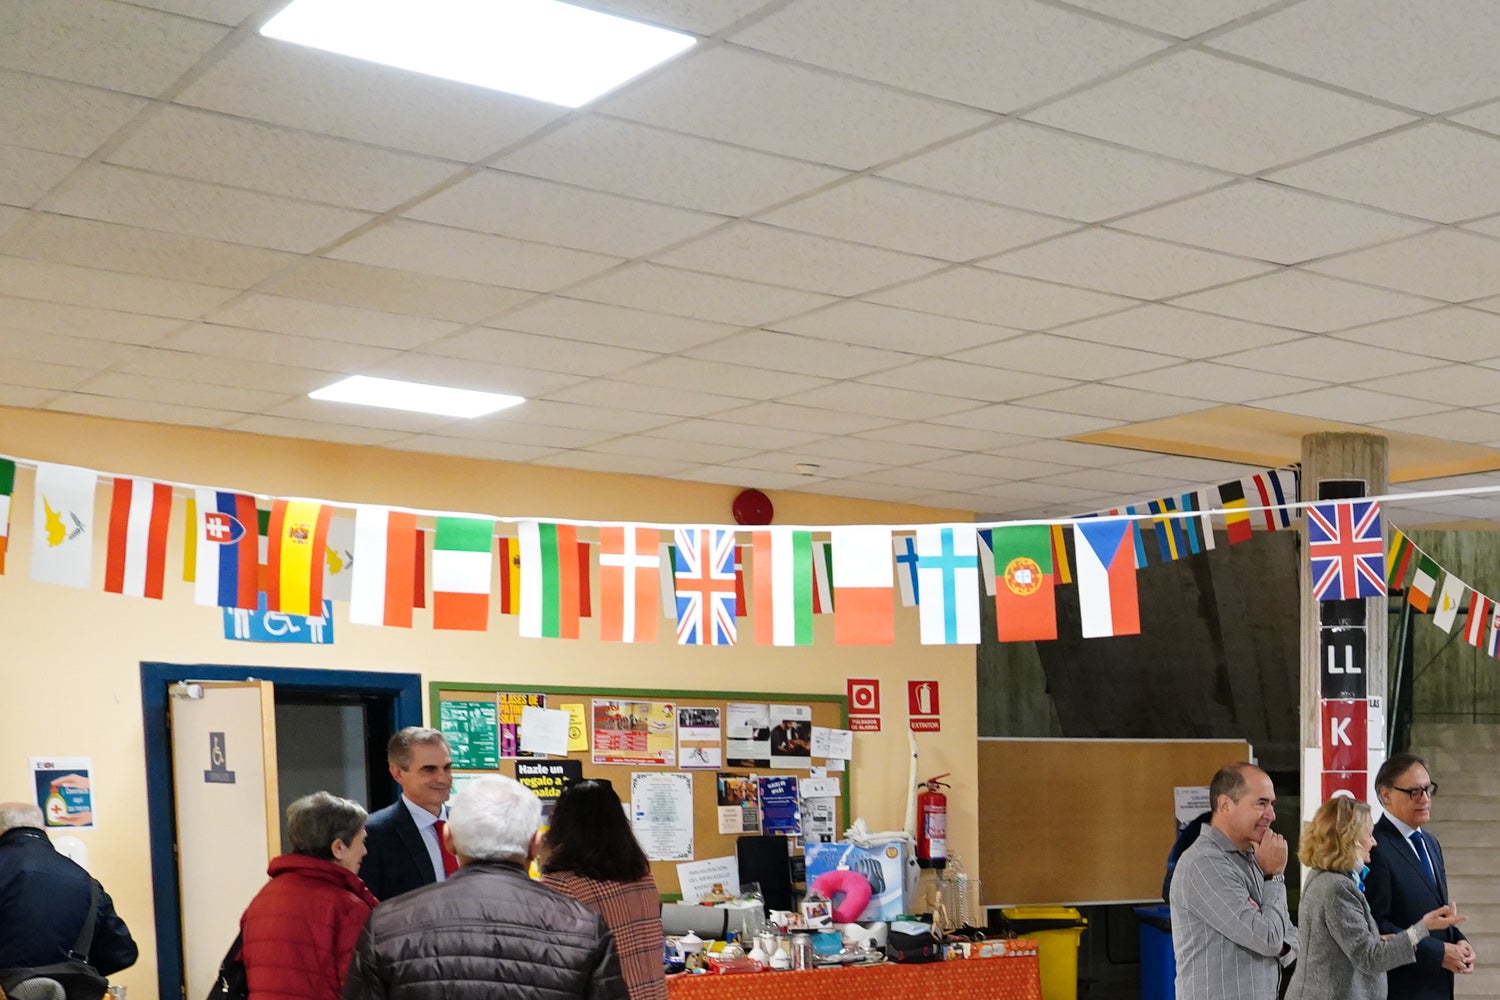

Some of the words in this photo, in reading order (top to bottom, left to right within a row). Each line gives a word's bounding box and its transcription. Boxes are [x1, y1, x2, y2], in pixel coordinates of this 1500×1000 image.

[1327, 644, 1362, 675] LL
[1368, 699, 1380, 708] LAS
[1330, 717, 1353, 747] K
[549, 765, 564, 775] un
